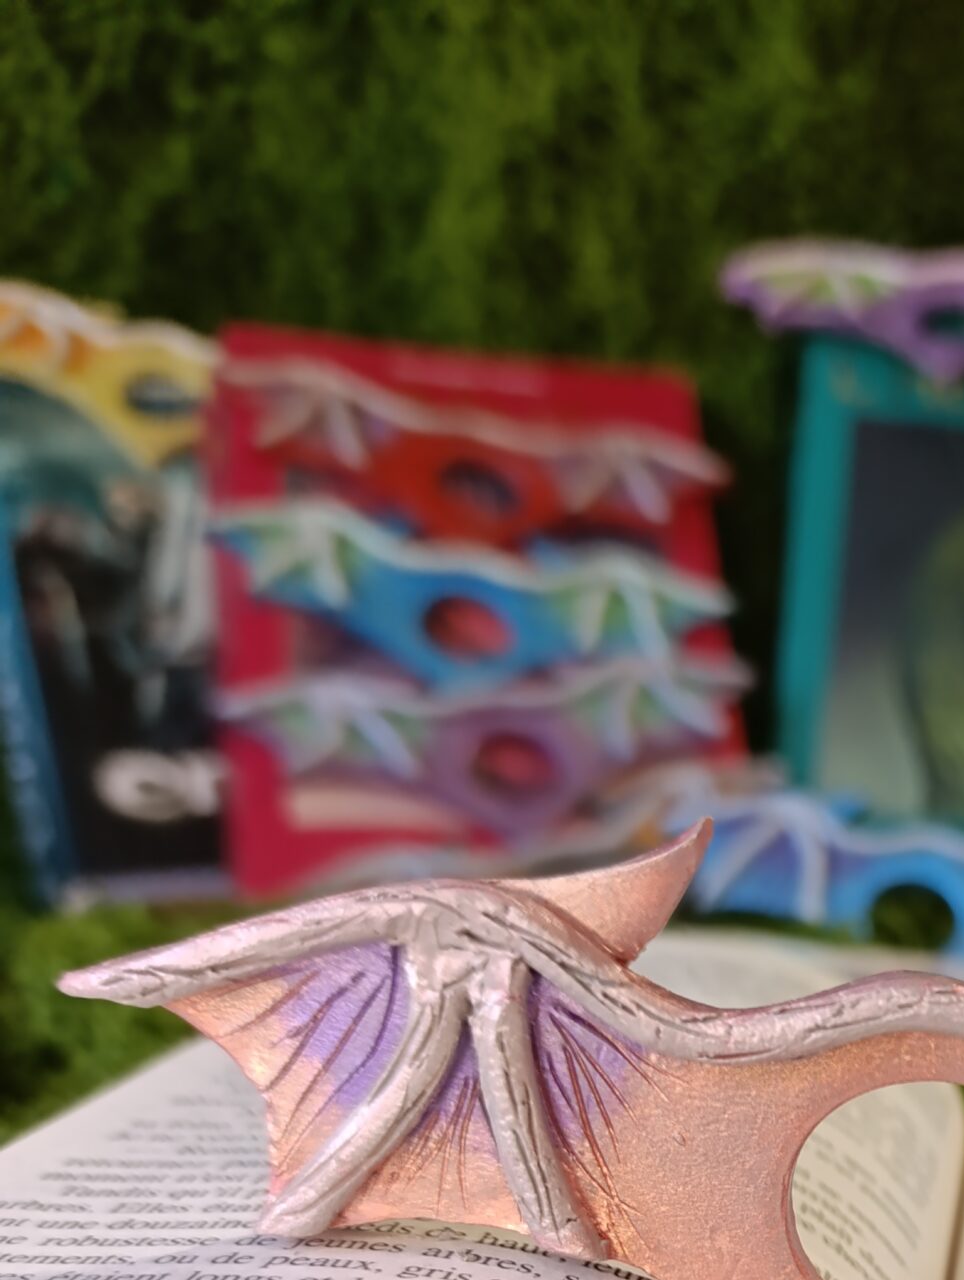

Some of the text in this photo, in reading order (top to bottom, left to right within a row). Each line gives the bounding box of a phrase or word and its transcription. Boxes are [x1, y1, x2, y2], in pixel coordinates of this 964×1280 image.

[37, 1220, 100, 1229] une
[0, 1253, 136, 1265] tements,
[152, 1253, 199, 1266] ou
[210, 1251, 255, 1266] de
[259, 1252, 383, 1273] peaux,
[37, 1234, 221, 1246] robustesse
[234, 1234, 277, 1246] de
[285, 1237, 407, 1254] jeunes
[421, 1246, 542, 1278] arbres,
